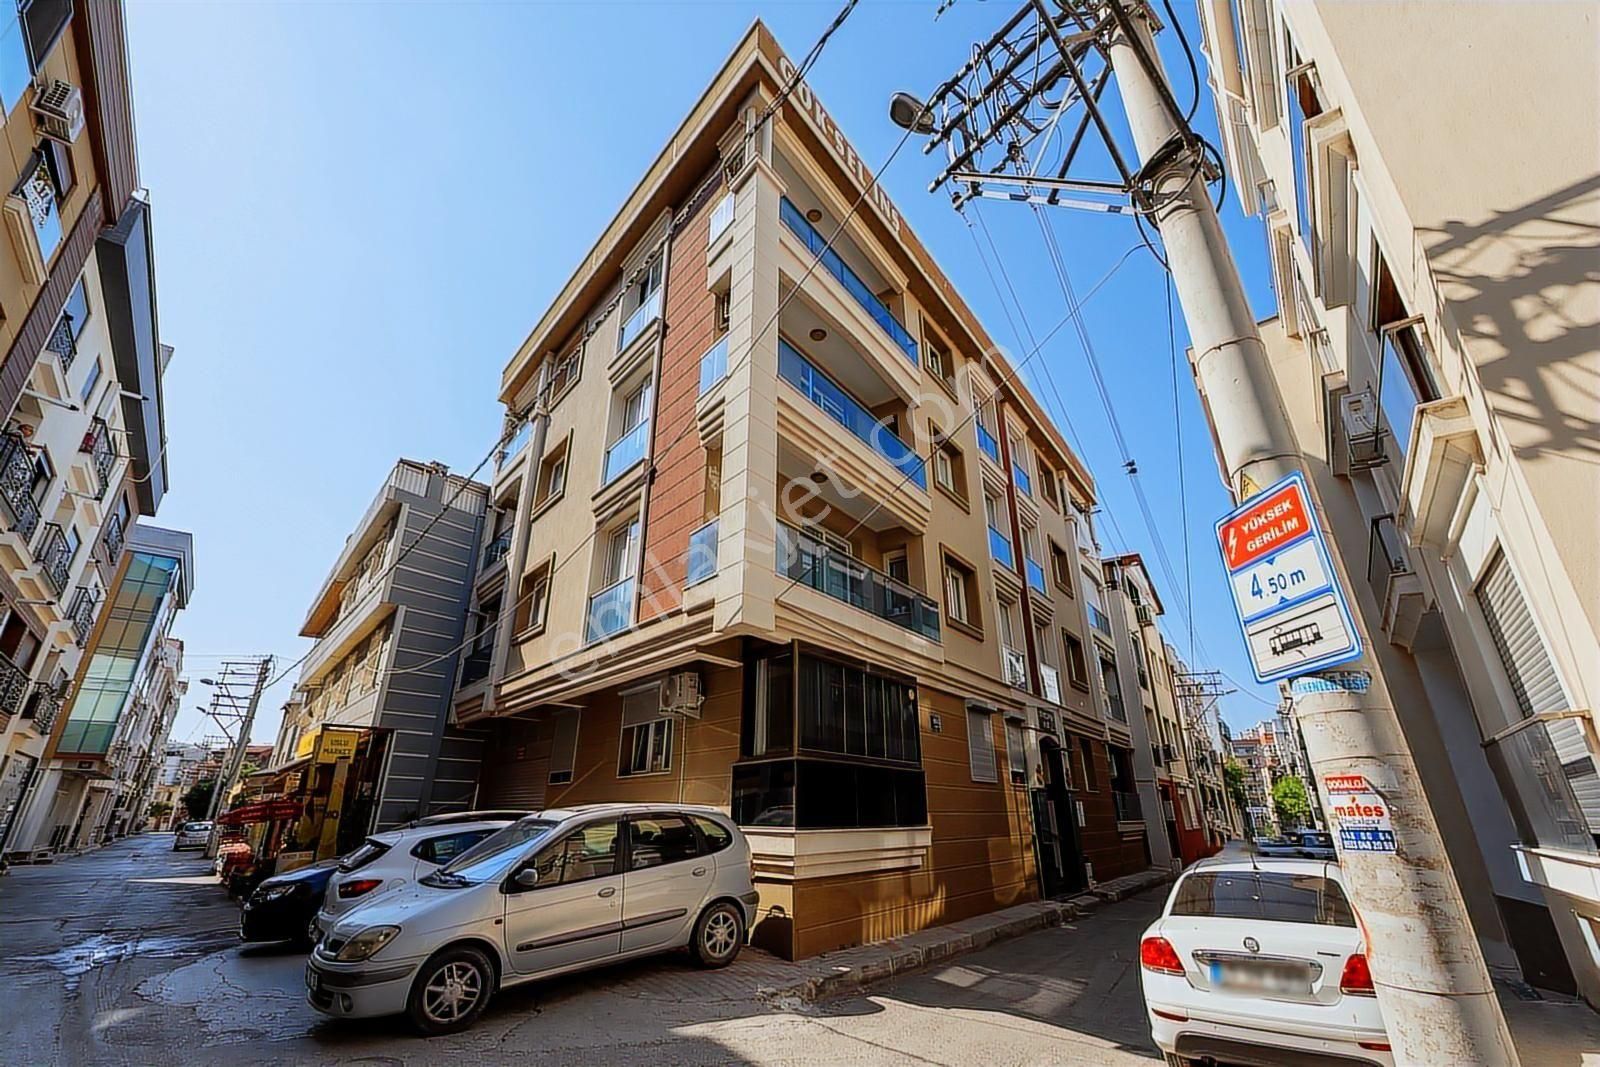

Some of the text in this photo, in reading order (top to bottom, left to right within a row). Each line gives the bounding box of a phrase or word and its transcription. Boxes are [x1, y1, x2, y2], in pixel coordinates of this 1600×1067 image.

[1241, 499, 1293, 535] YÜKSEK
[1246, 518, 1299, 552] GERİLİM
[1290, 569, 1306, 586] m
